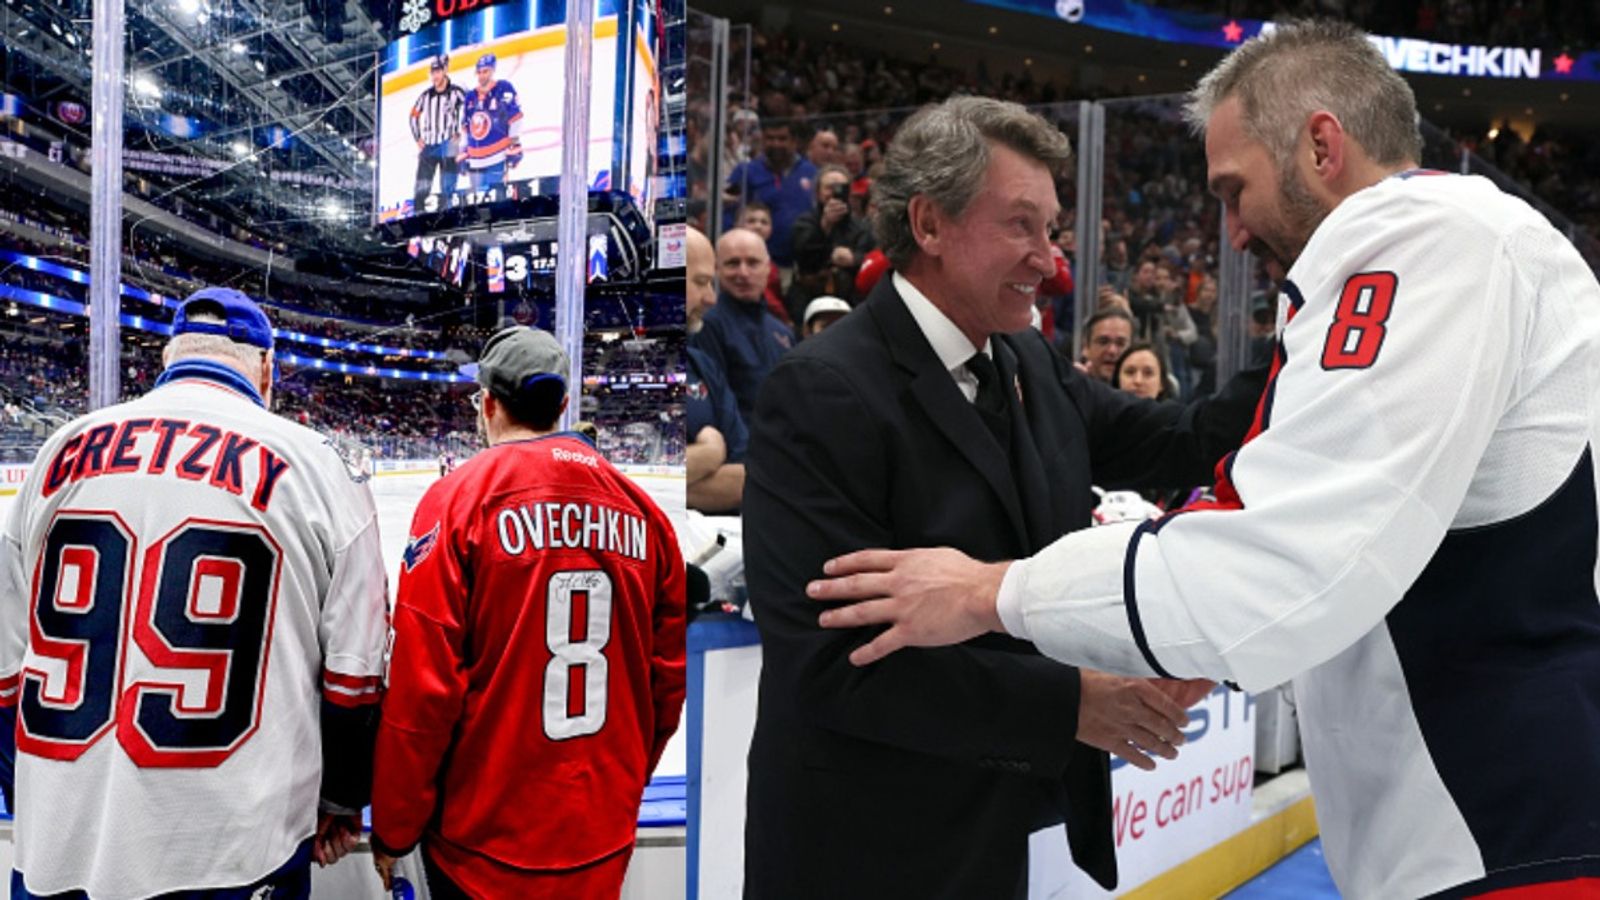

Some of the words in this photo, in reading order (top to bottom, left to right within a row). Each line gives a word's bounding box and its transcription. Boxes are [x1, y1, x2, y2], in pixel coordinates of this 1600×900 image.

[505, 255, 528, 281] 3
[1321, 271, 1398, 371] 8
[42, 418, 290, 512] GRETZKY
[498, 502, 647, 561] OVECHKIN
[15, 509, 284, 768] 99
[542, 570, 612, 741] 8
[1155, 775, 1203, 828] can
